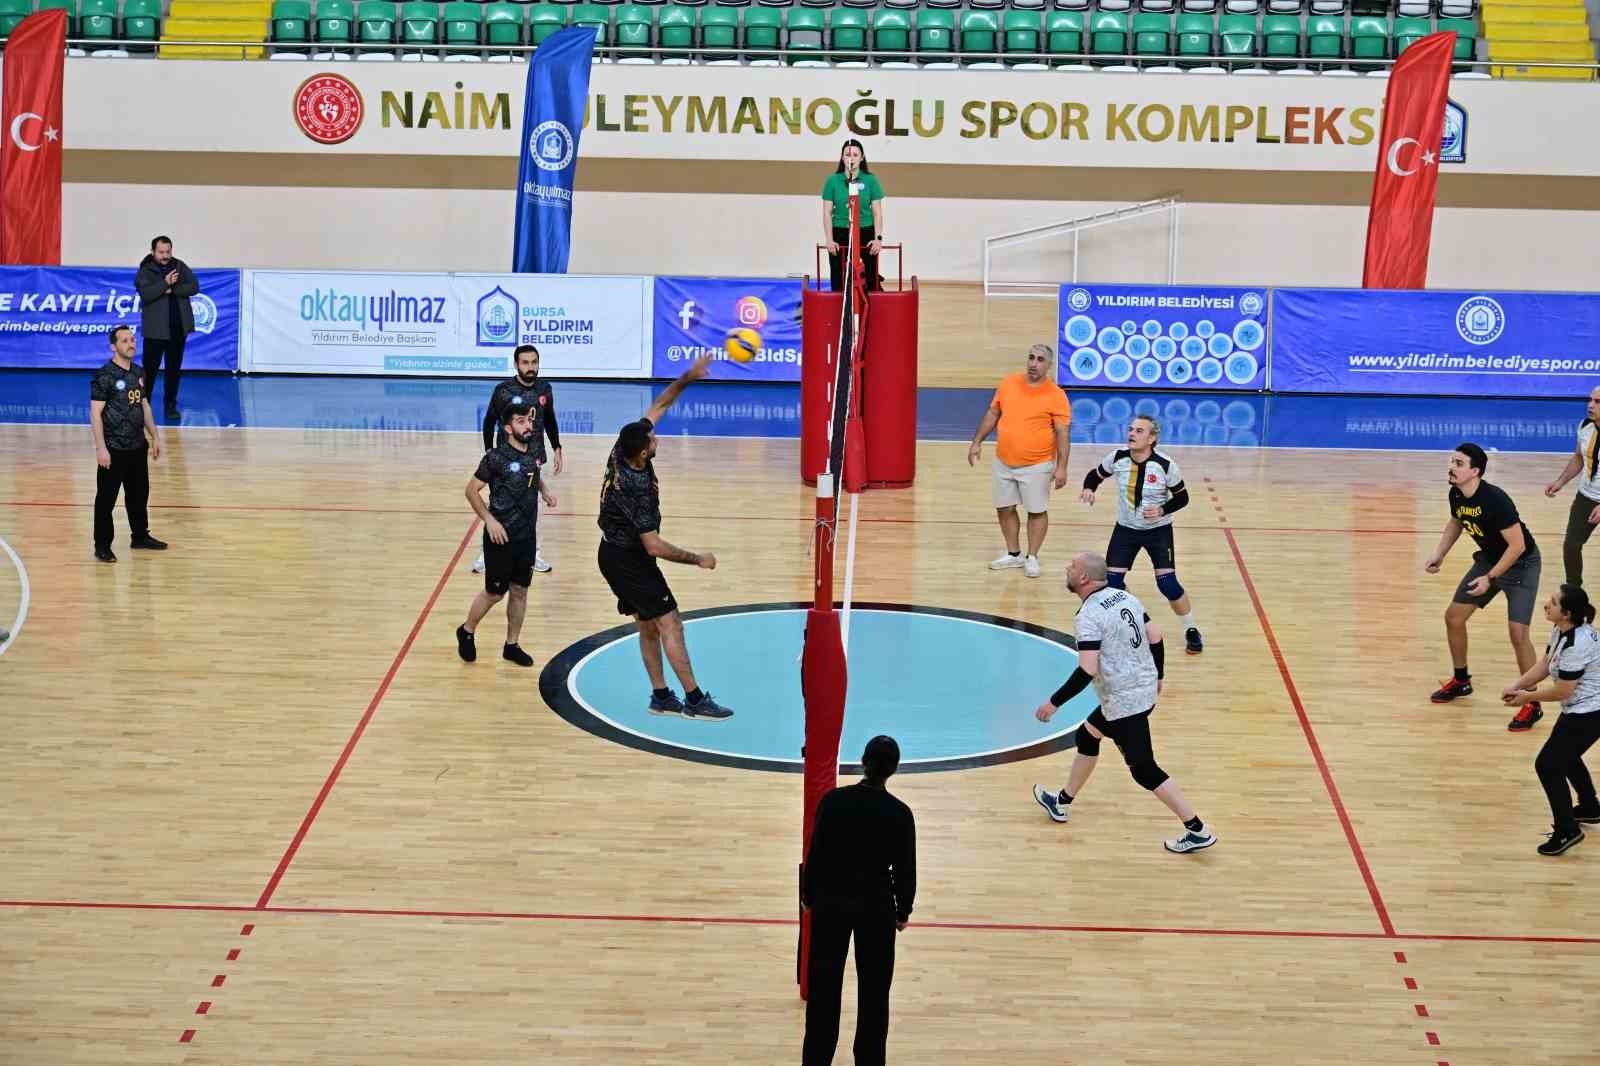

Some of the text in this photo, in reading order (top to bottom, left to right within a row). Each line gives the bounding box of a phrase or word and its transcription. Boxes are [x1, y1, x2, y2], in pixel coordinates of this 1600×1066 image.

[380, 81, 511, 130] NAİM
[584, 89, 945, 138] LEYMANOĞLU
[959, 100, 1089, 141] SPOR
[1105, 98, 1387, 146] KOMPLEKS
[20, 293, 101, 313] KAYIT
[1096, 295, 1155, 307] YILDIRIM
[1157, 294, 1234, 309] BELEDİYESİ
[522, 306, 567, 317] BURSA
[523, 319, 593, 332] YILDIRIM
[351, 333, 395, 344] Belediye
[527, 472, 535, 488] 7
[1120, 608, 1142, 648] 3
